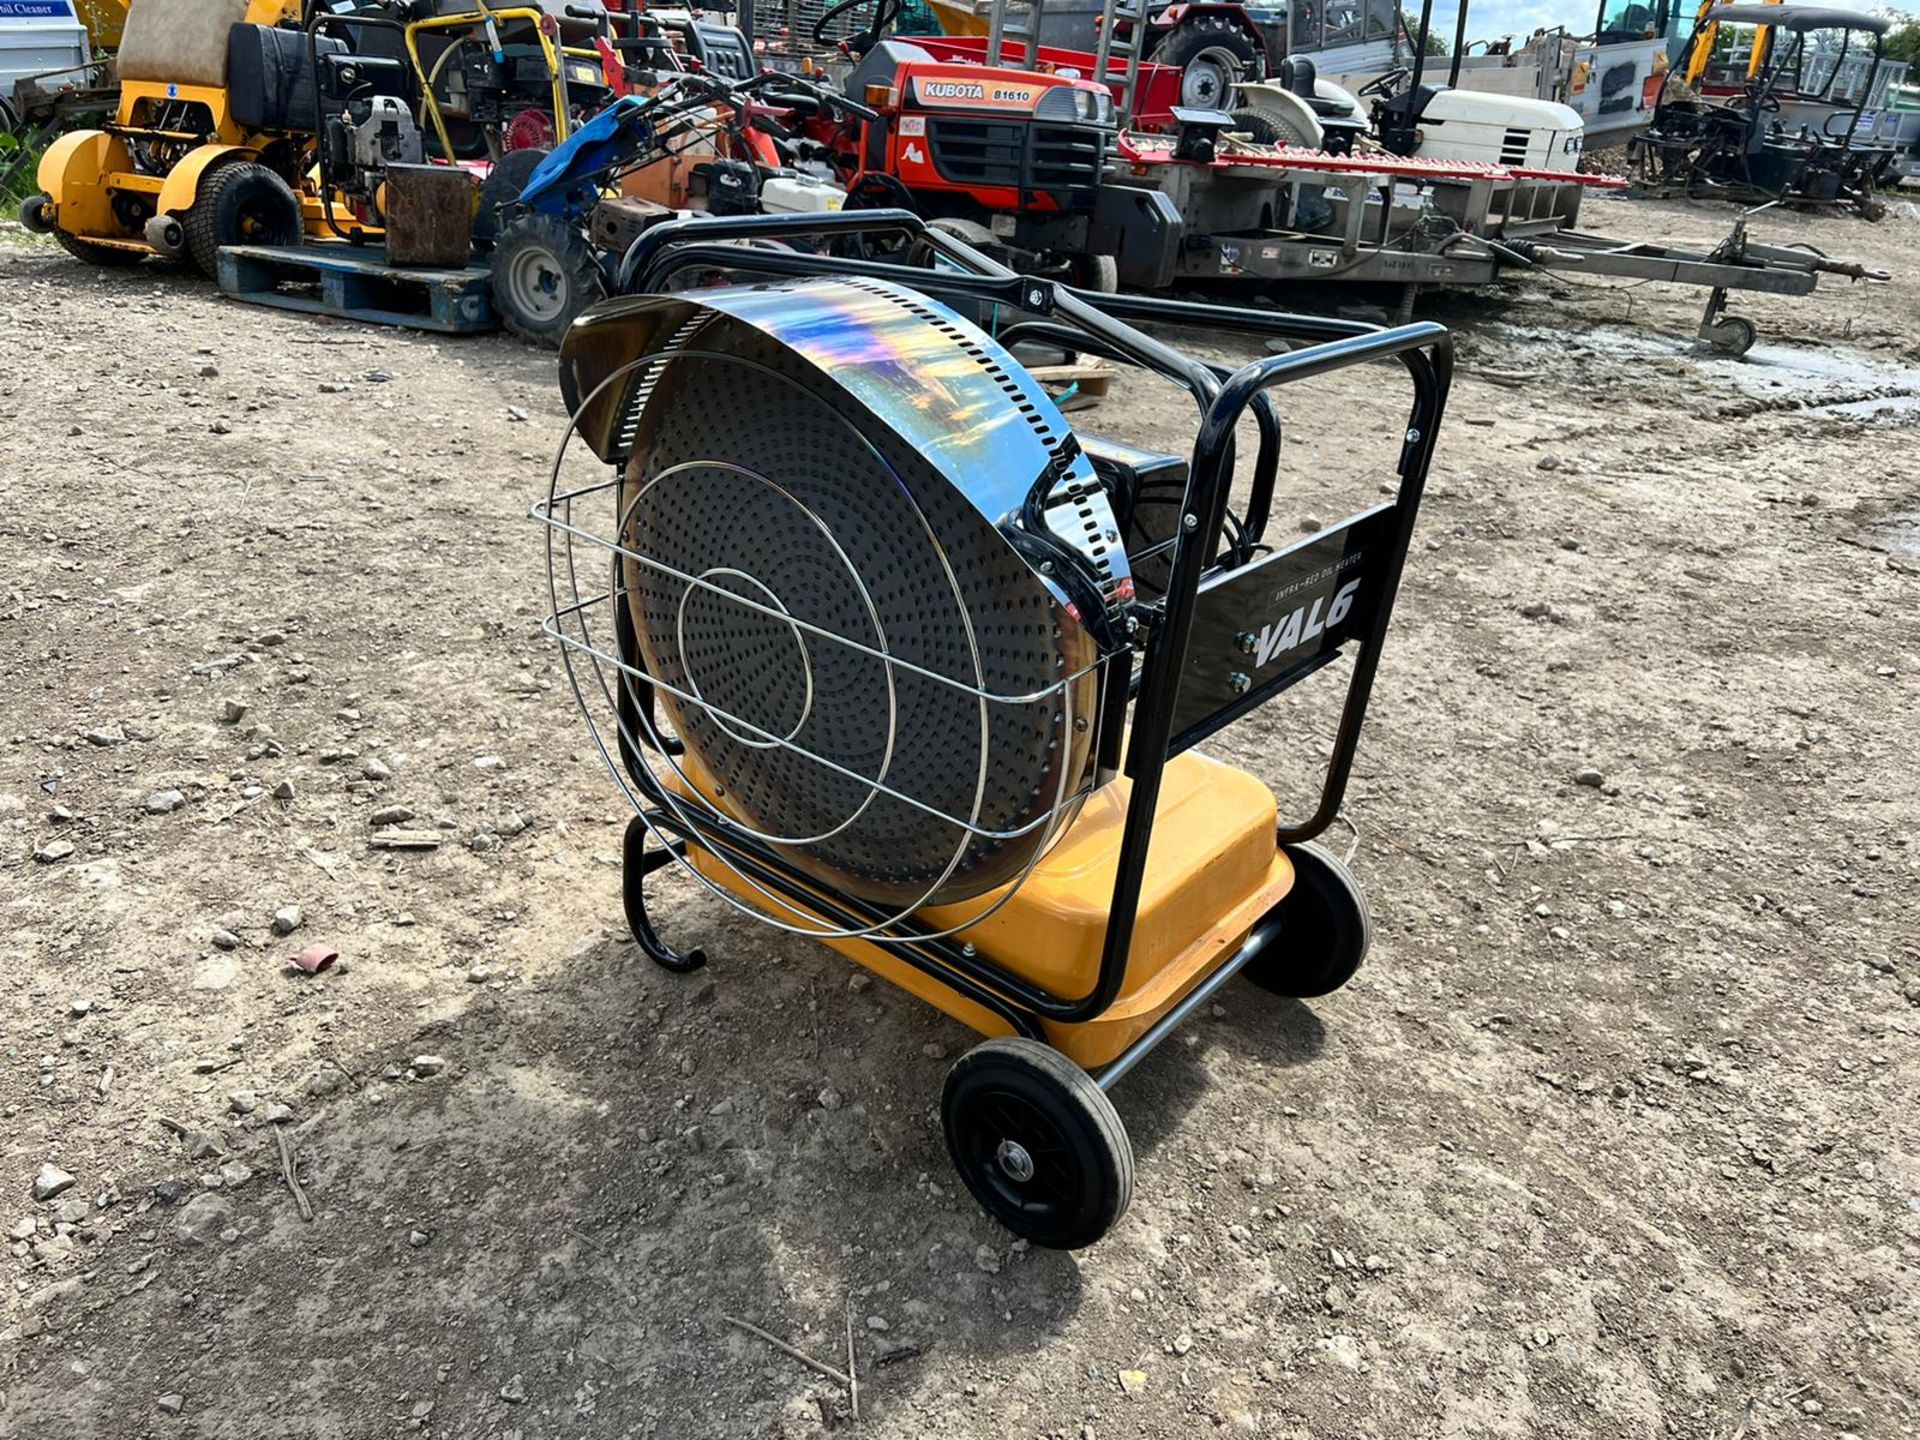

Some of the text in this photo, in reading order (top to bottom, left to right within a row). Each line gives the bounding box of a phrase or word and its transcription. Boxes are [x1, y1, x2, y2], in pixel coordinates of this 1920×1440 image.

[14, 3, 53, 14] Cleaner
[924, 82, 983, 100] KUBOTA
[1256, 576, 1362, 670] VAL6
